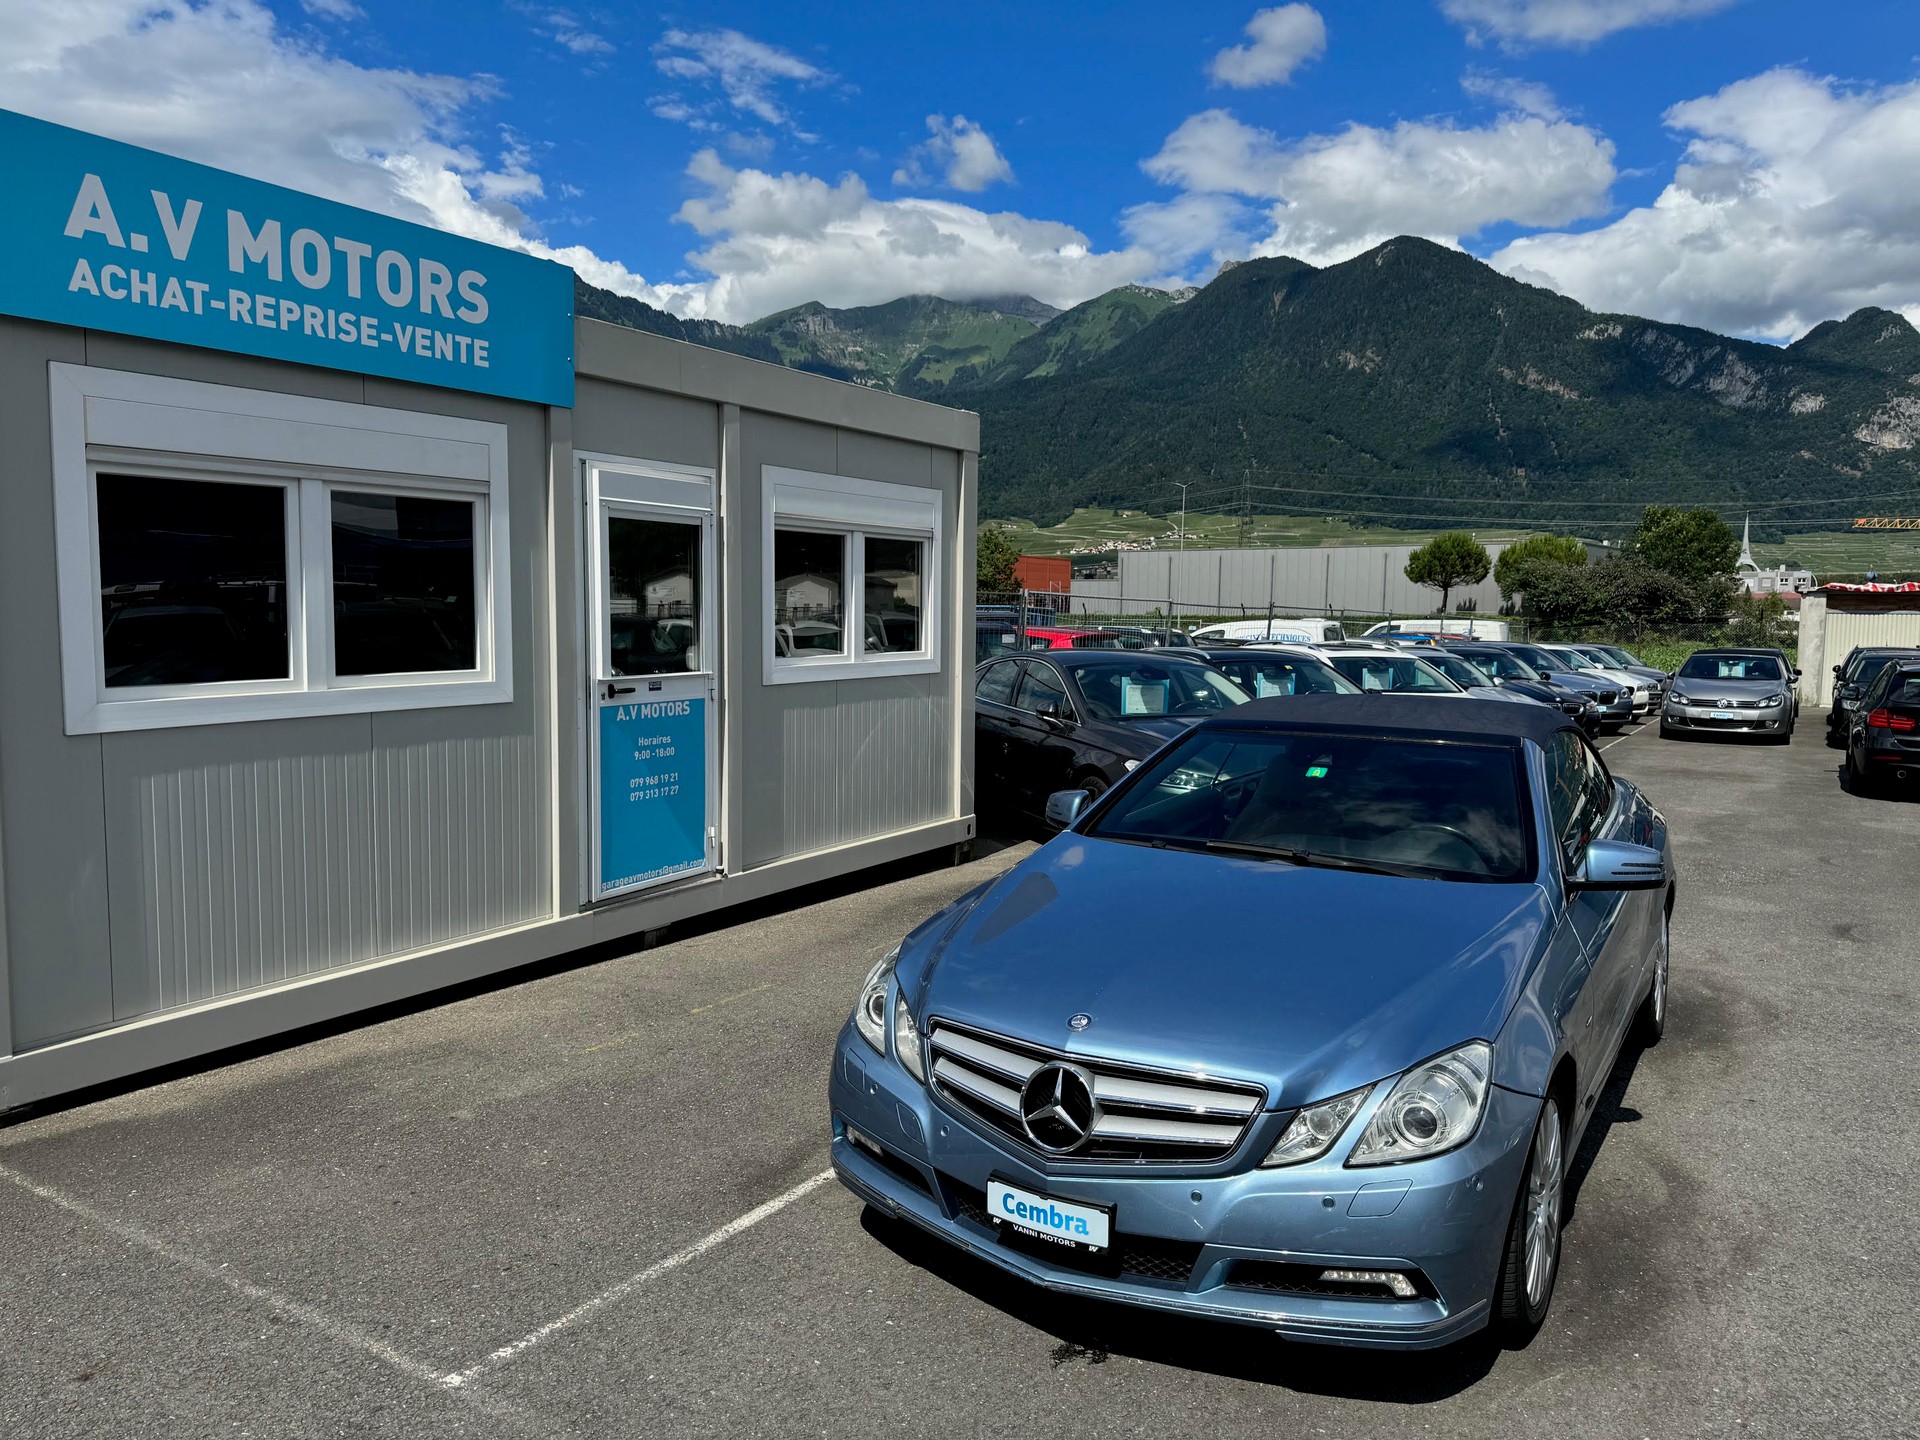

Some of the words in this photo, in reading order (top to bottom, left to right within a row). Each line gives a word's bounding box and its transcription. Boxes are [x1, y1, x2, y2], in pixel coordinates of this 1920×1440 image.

[64, 173, 203, 261] A.V
[227, 209, 489, 324] MOTORS
[68, 259, 490, 368] ACHAT-REPRISE-VENTE
[617, 705, 638, 721] A.V
[641, 701, 690, 719] MOTORS
[638, 735, 671, 746] Horaires
[634, 751, 651, 760] 9:00
[630, 779, 644, 788] 079
[645, 775, 659, 785] 968
[661, 774, 669, 783] 19
[670, 772, 678, 781] 21
[630, 792, 644, 802] 079
[645, 788, 659, 799] 313
[661, 787, 669, 796] 17
[670, 785, 679, 795] 27
[602, 858, 704, 891] garageavmotors@gmail.com
[1002, 1192, 1089, 1236] Cembra
[1012, 1224, 1038, 1238] VANNI
[1039, 1233, 1076, 1248] MOTORS
